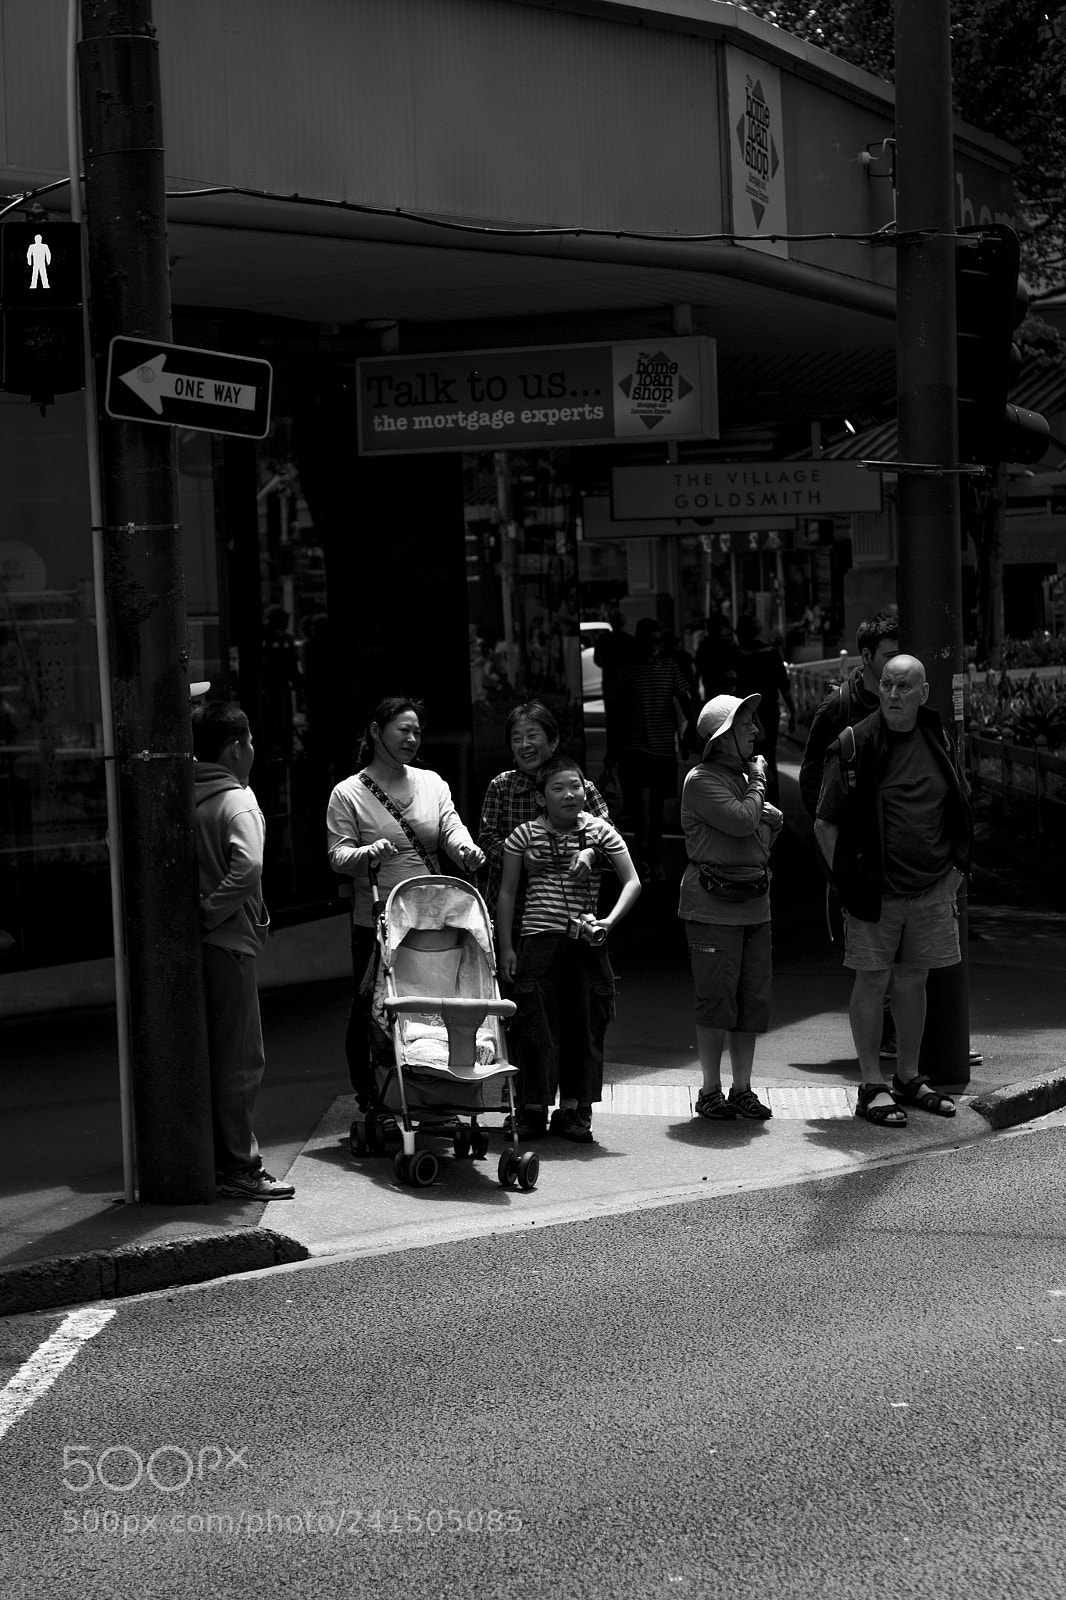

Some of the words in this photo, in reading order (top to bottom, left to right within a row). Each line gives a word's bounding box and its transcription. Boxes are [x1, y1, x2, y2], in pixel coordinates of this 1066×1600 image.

[745, 86, 770, 129] home
[747, 115, 769, 152] loan
[745, 141, 769, 181] shop
[636, 359, 678, 375] home
[637, 374, 673, 387] loan
[174, 377, 205, 399] ONE
[214, 383, 242, 404] WAY
[366, 371, 458, 408] Talk
[467, 370, 507, 402] to
[518, 371, 601, 399] us...
[632, 385, 674, 403] shop
[372, 414, 409, 432] the
[413, 409, 516, 431] mortgage
[520, 403, 605, 426] experts
[674, 473, 713, 488] THE
[727, 469, 821, 486] VILLAGE
[675, 490, 821, 510] GOLDSMITH
